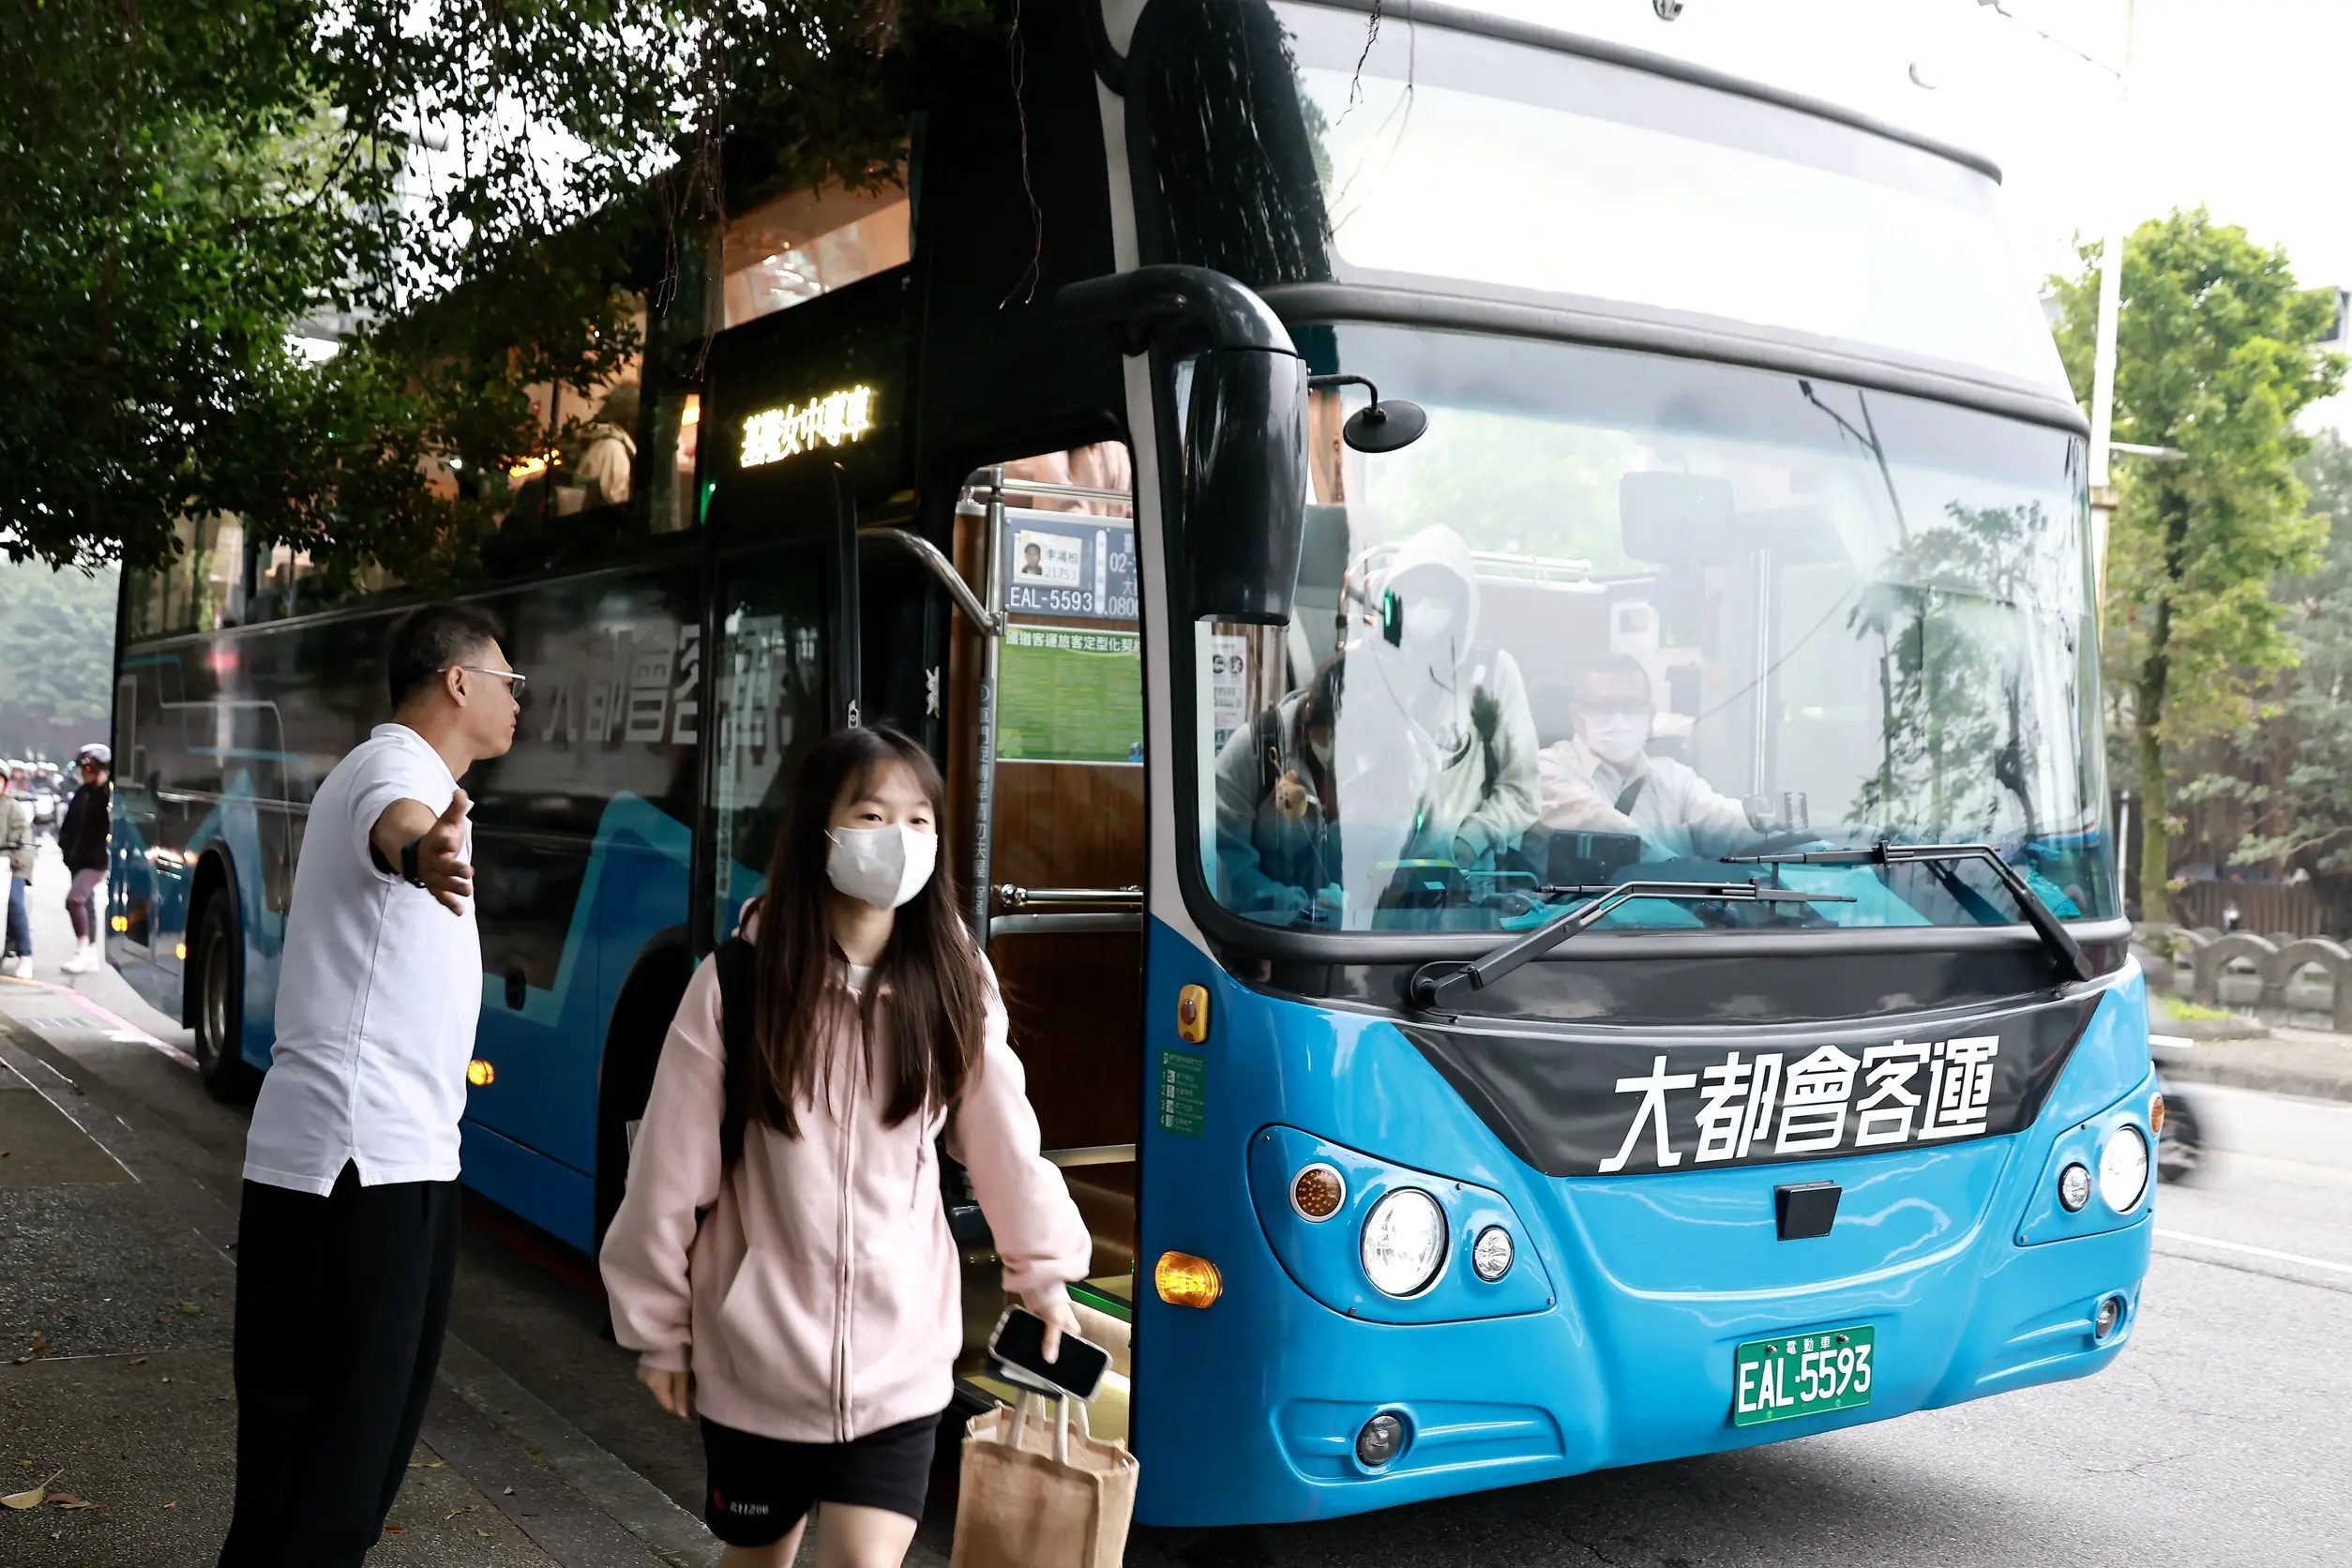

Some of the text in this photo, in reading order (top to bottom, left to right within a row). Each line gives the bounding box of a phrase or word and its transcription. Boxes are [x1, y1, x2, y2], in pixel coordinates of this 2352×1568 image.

[1010, 586, 1093, 611] EAL-5593
[1598, 1035, 1999, 1173] 大都會客運
[1786, 1335, 1831, 1355] 電動車
